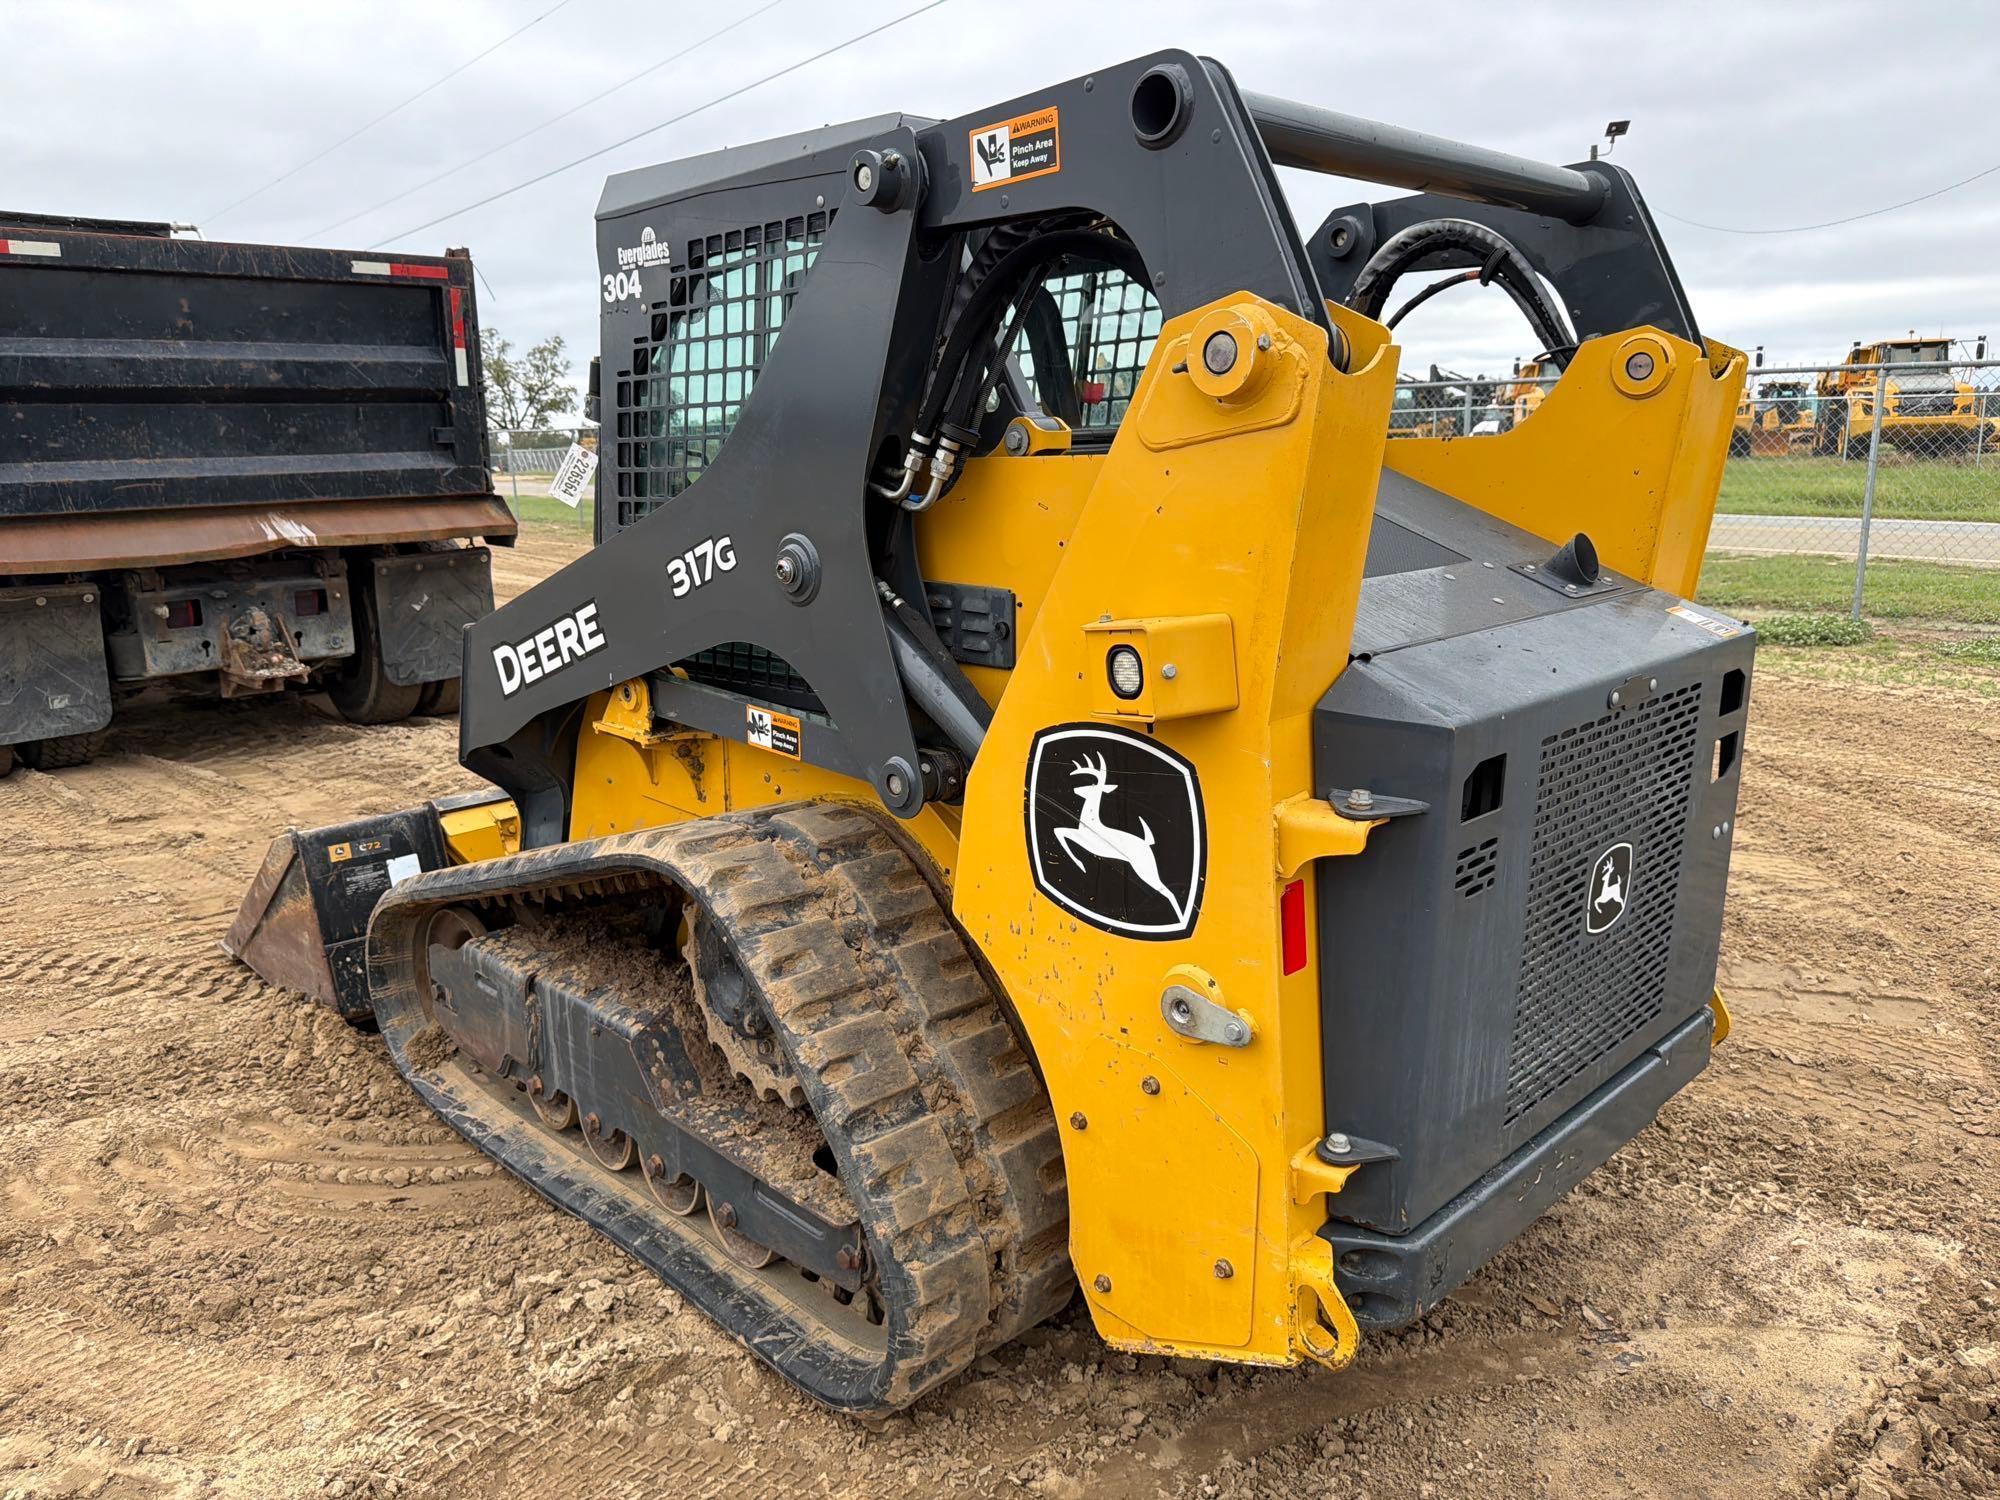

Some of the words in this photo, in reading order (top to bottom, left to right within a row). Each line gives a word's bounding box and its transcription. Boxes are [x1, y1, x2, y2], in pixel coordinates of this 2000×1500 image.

[1019, 114, 1054, 131] WARNING
[1012, 141, 1034, 156] Pinch
[1035, 138, 1053, 151] Area
[1013, 158, 1030, 169] Keep
[1030, 153, 1048, 164] Away
[617, 241, 670, 266] Everglades
[603, 269, 643, 303] 304
[561, 458, 590, 497] 226564
[666, 536, 737, 597] 317G
[492, 602, 606, 696] DEERE
